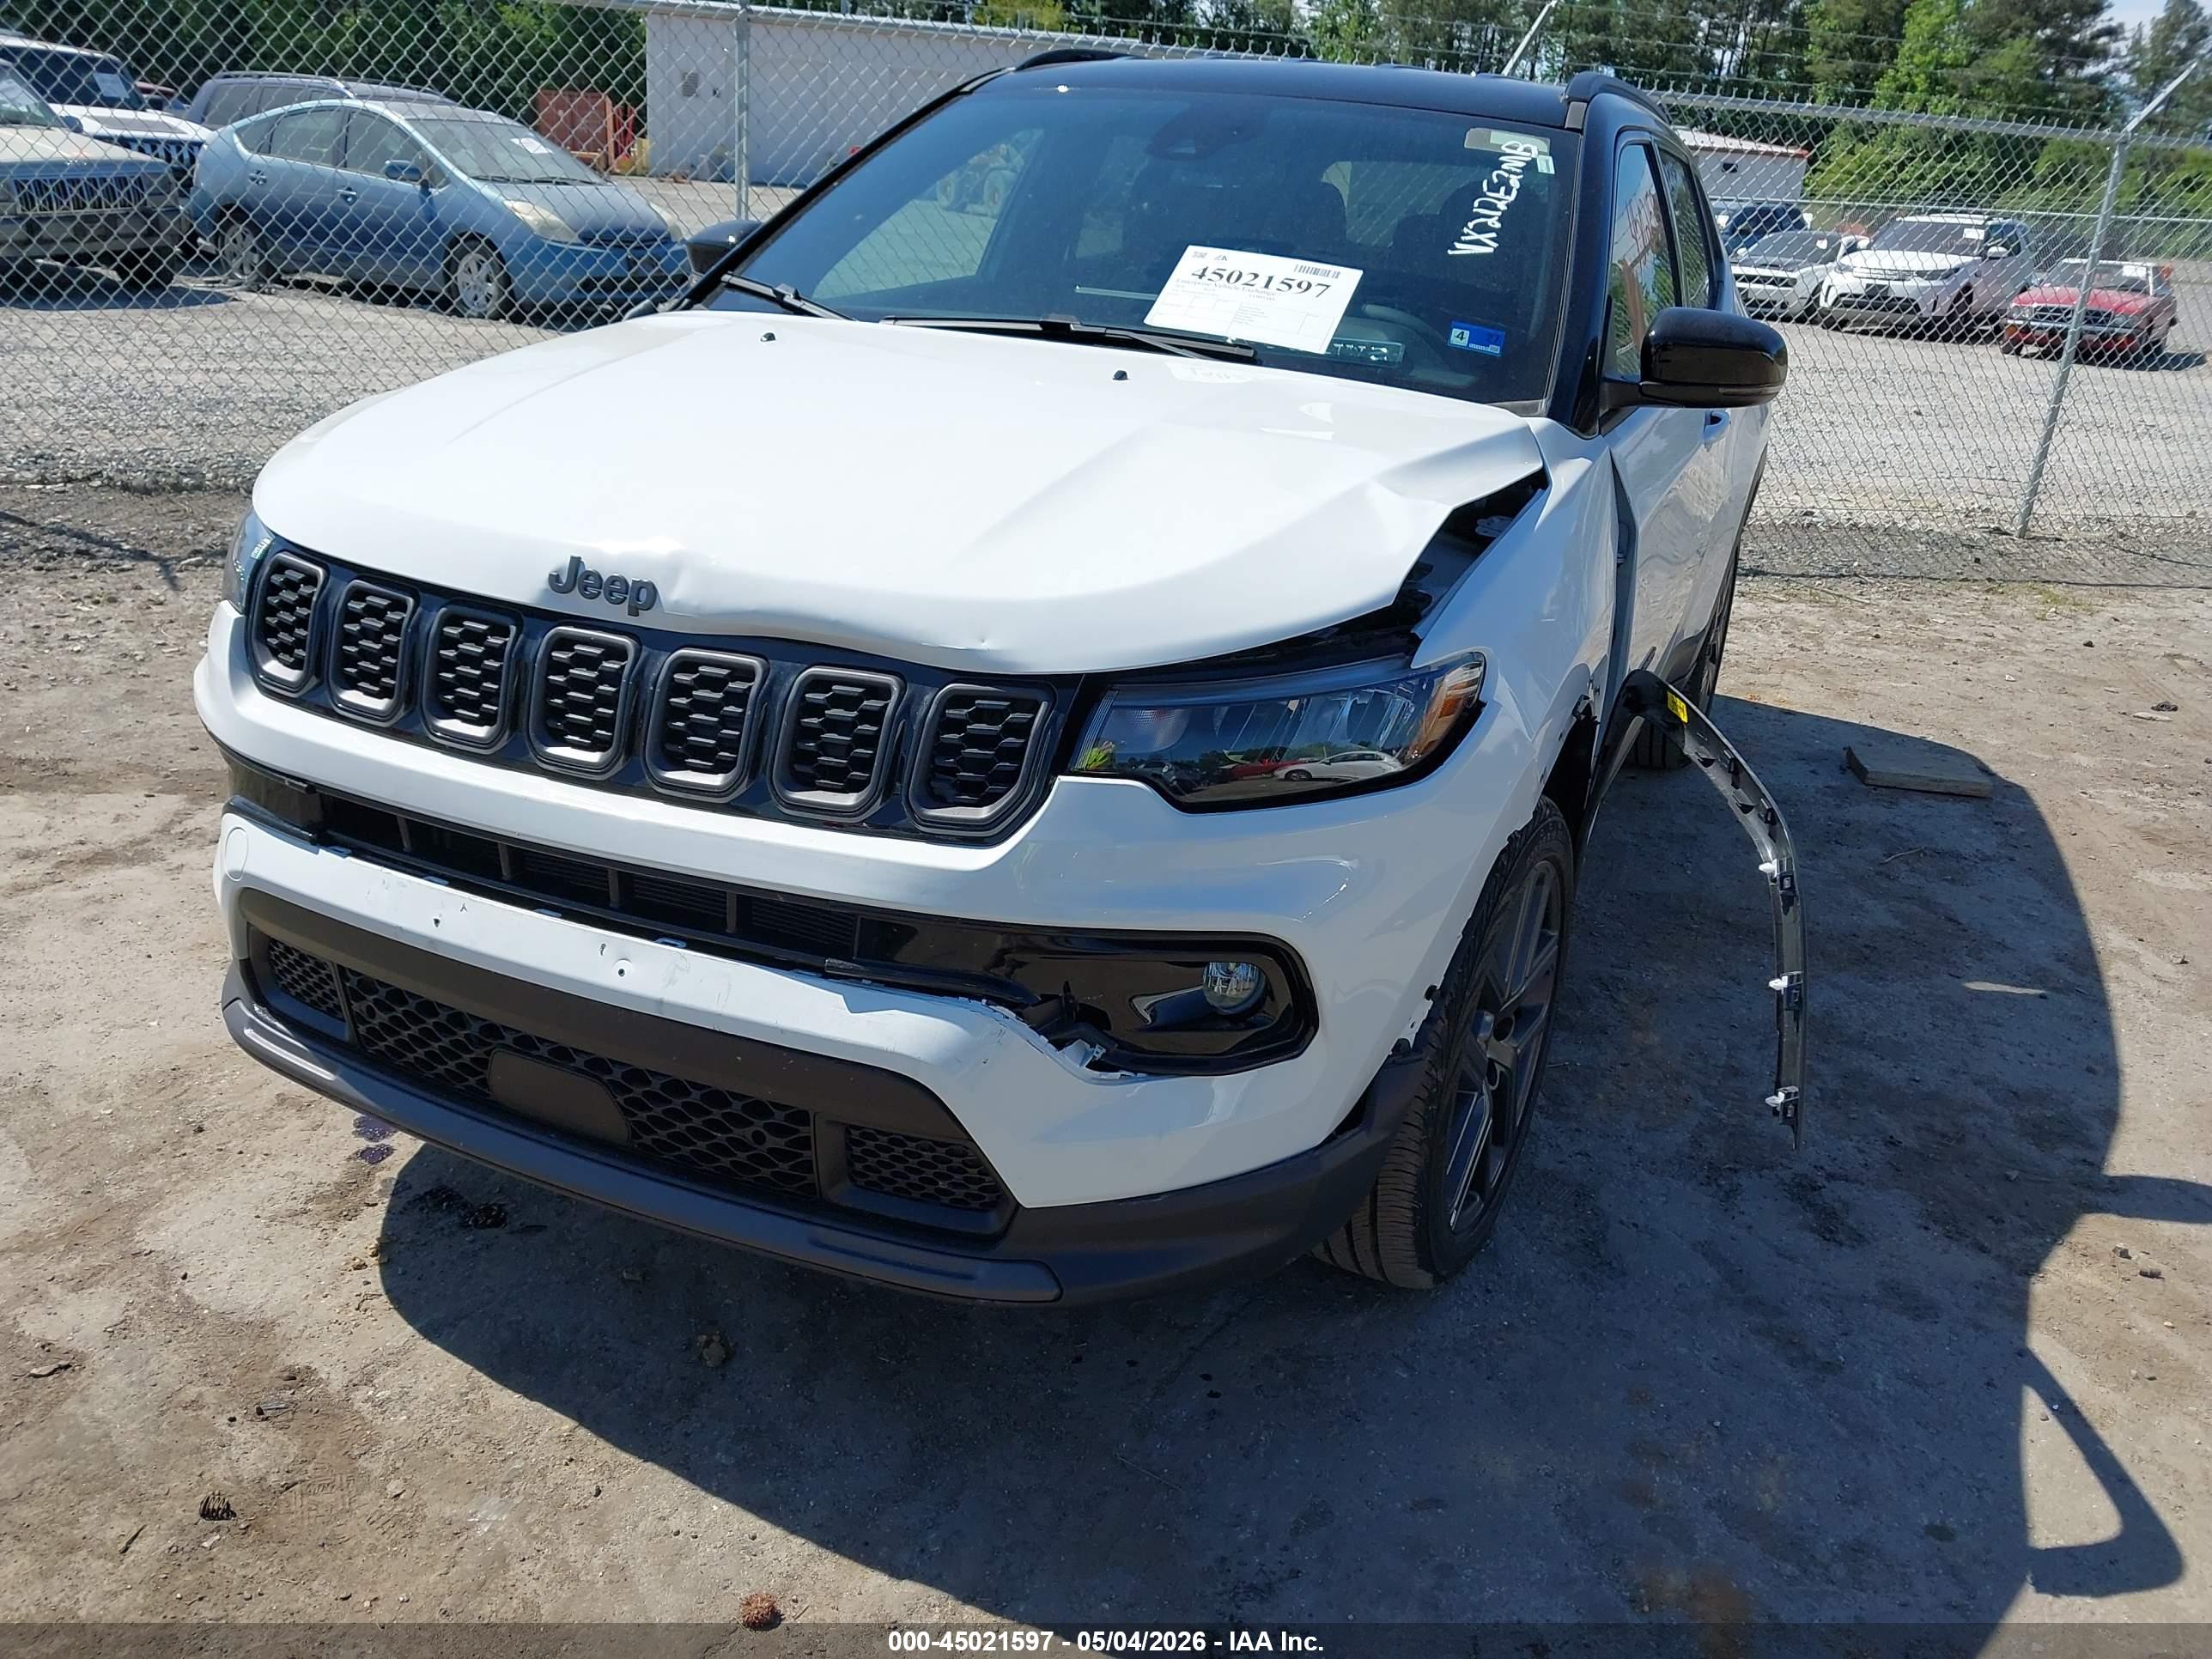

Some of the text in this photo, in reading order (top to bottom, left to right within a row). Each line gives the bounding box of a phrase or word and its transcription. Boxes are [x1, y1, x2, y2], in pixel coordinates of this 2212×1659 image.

[1191, 265, 1331, 298] 45021597
[1455, 331, 1466, 341] 4
[548, 555, 658, 617] Jeep
